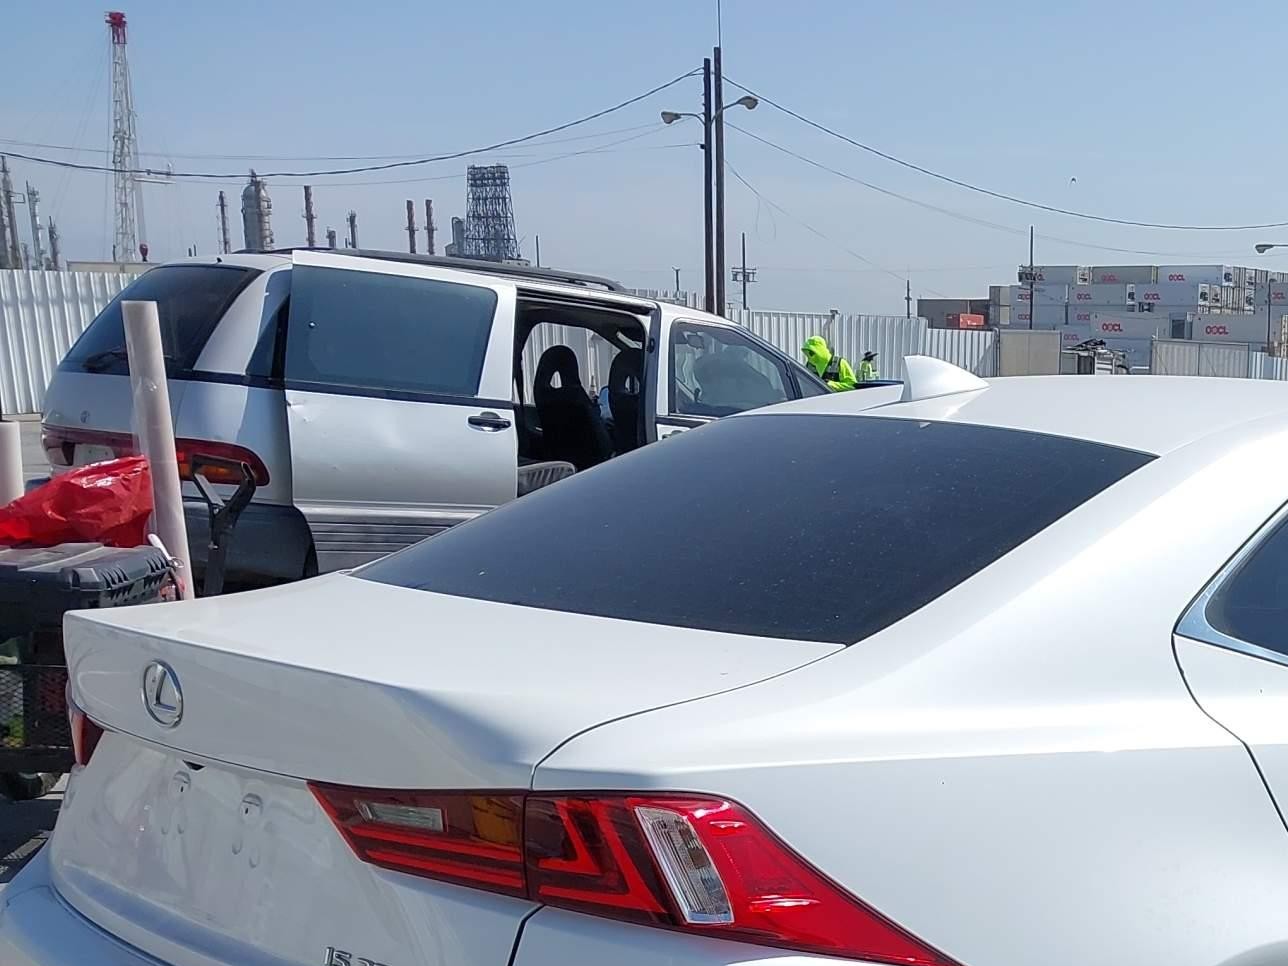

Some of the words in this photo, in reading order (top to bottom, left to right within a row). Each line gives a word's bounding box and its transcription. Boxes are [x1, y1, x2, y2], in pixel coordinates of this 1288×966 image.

[1077, 313, 1090, 321] OOC
[1102, 323, 1123, 332] OOCL
[1205, 325, 1229, 335] OOCL
